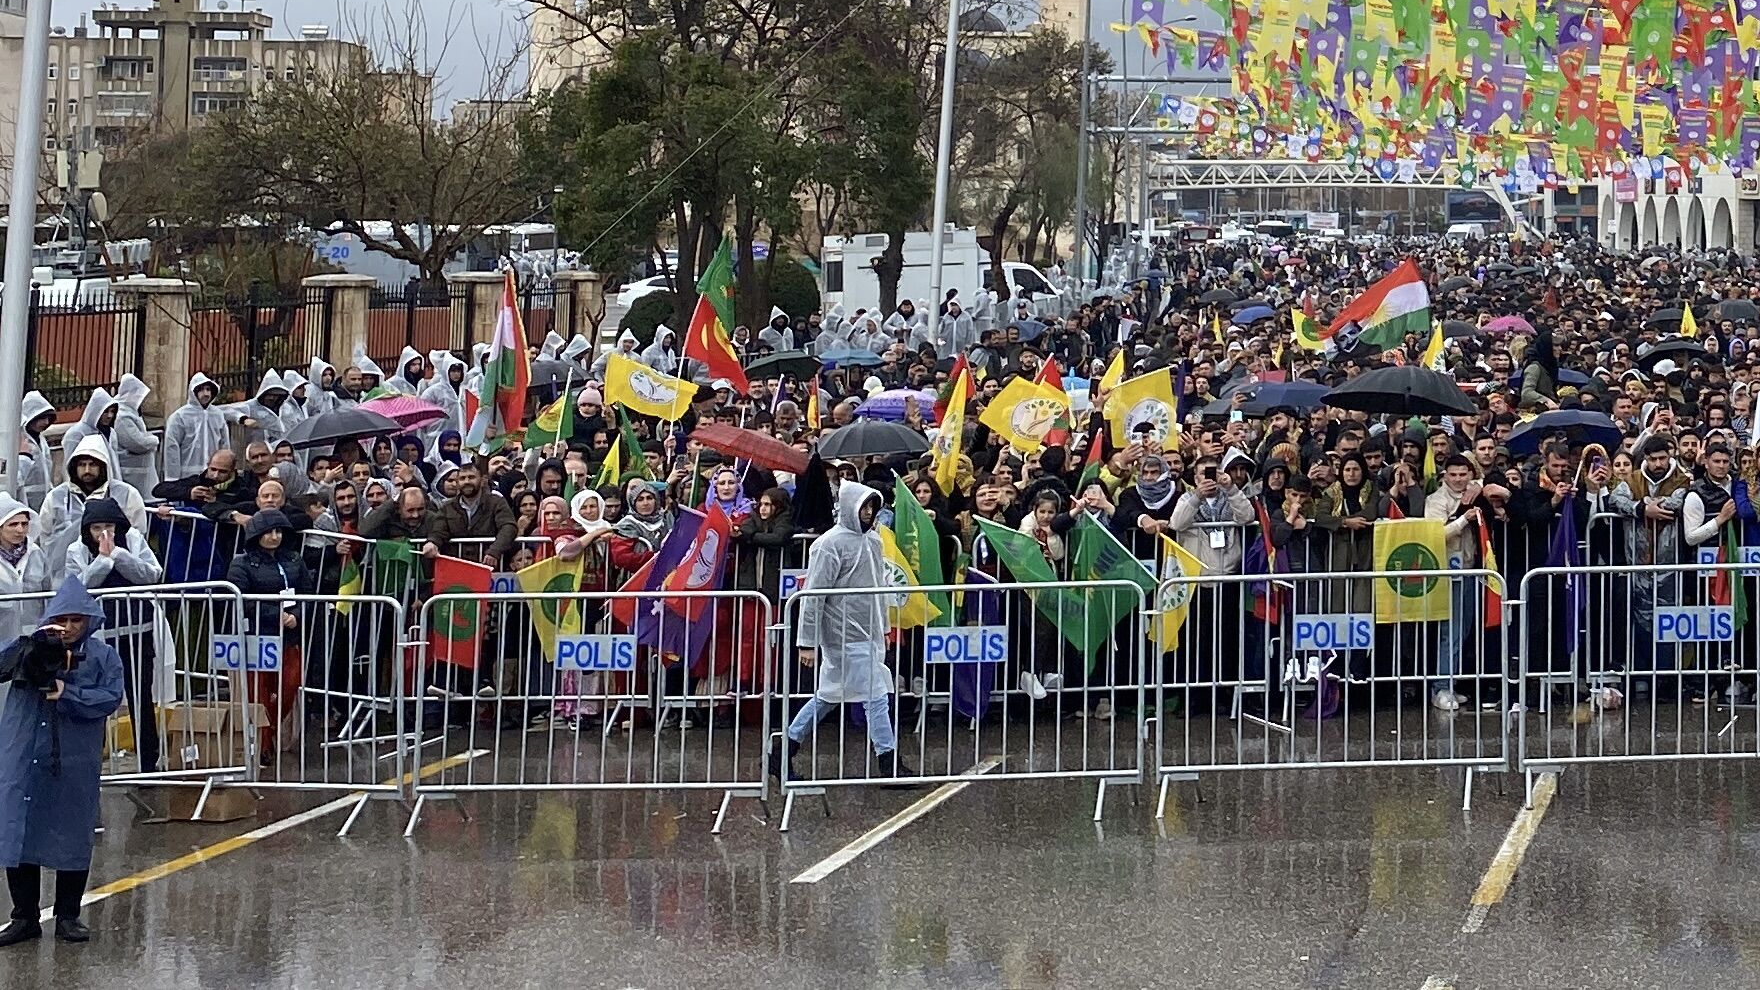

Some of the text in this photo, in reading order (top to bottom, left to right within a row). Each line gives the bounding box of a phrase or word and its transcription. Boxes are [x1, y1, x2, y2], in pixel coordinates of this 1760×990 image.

[1295, 616, 1372, 650] POLİS
[1658, 608, 1732, 641] POLİS
[557, 637, 634, 671] POLİS
[926, 629, 1005, 663] POLİS
